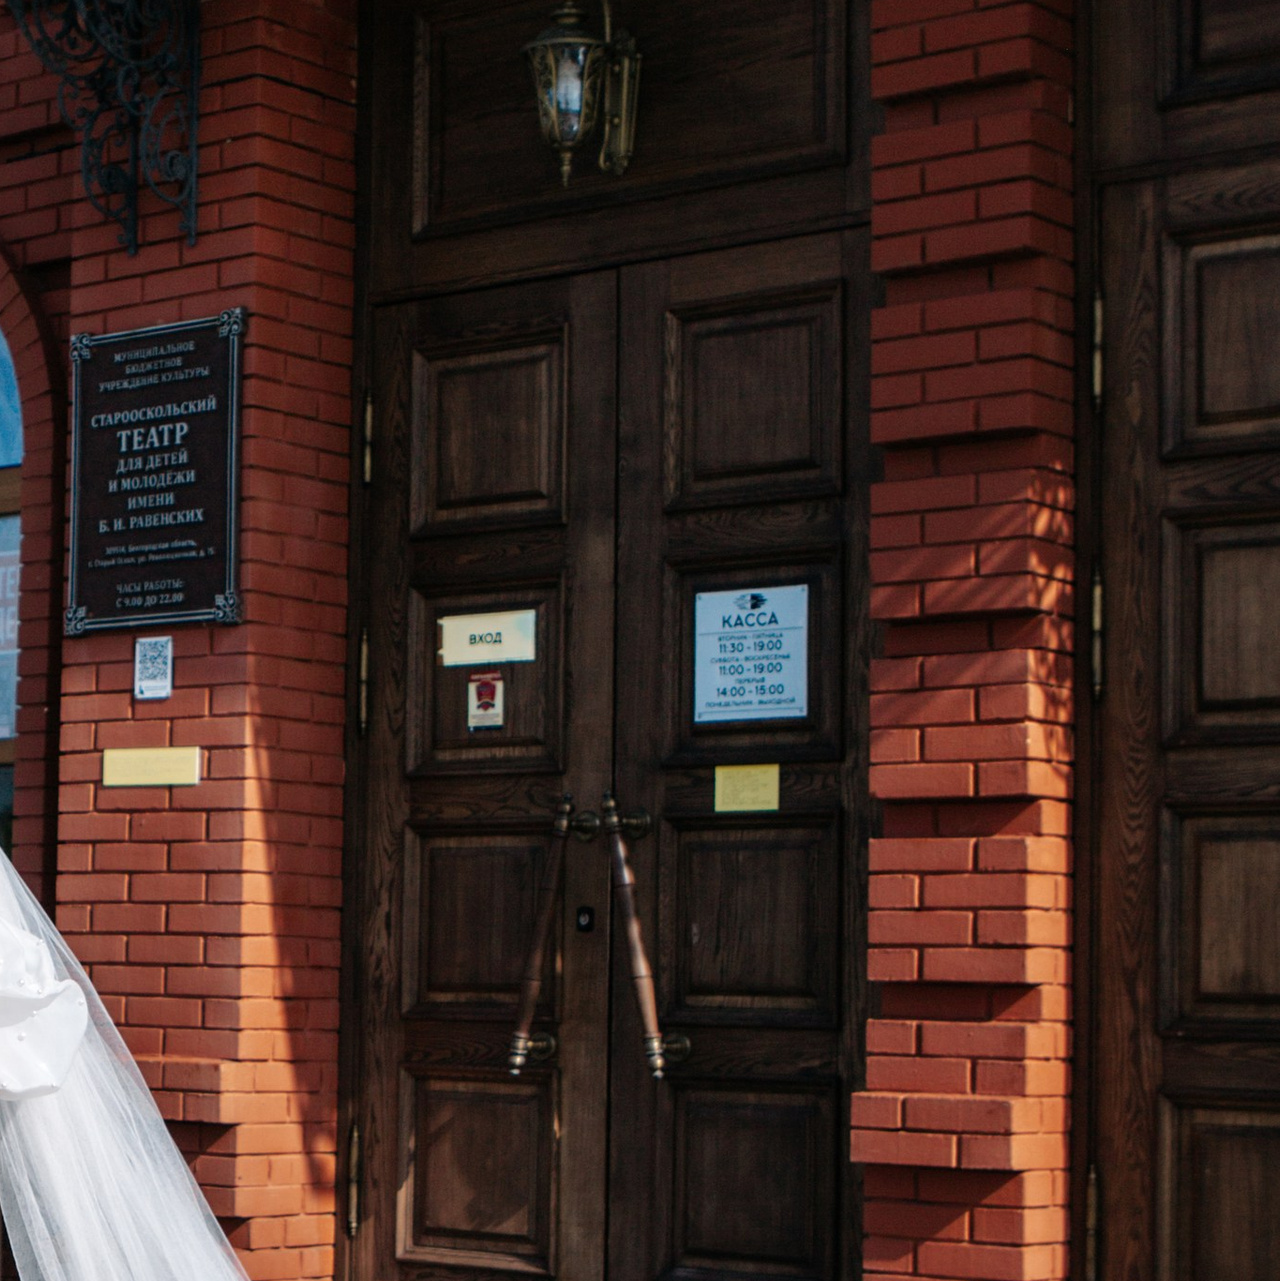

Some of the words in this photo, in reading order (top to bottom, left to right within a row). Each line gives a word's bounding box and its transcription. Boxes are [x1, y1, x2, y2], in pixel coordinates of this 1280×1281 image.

[113, 340, 195, 363] МУНИЦИПАЛЬНОЕ
[125, 356, 183, 374] БЮДЖЕТНОЕ
[99, 374, 159, 392] УЧРЕЖДЕНИЕ
[161, 366, 210, 382] КУЛЬТУРЫ
[91, 394, 217, 428] СТАРООСКОЛЬСКИЙ
[116, 422, 189, 452] ТЕАТР
[116, 457, 142, 474] ДЛЯ
[145, 448, 188, 471] ДЕТЕЙ
[108, 479, 118, 493] И
[128, 492, 175, 510] ИМЕНИ
[129, 508, 204, 529] РАВЕНСКИХ
[117, 581, 141, 594] ЧАСЫ
[144, 578, 183, 592] РАБОТЫ:
[115, 598, 122, 608] С
[125, 595, 142, 607] 9.00
[144, 594, 156, 607] ДО
[722, 611, 779, 628] КАССА
[469, 632, 502, 645] ВХОД
[719, 642, 744, 653] 11:30
[753, 639, 783, 651] 19:00
[719, 664, 744, 675] 11:00
[753, 662, 783, 674] 19:00
[716, 685, 746, 697] 14:00
[755, 683, 784, 695] 15:00
